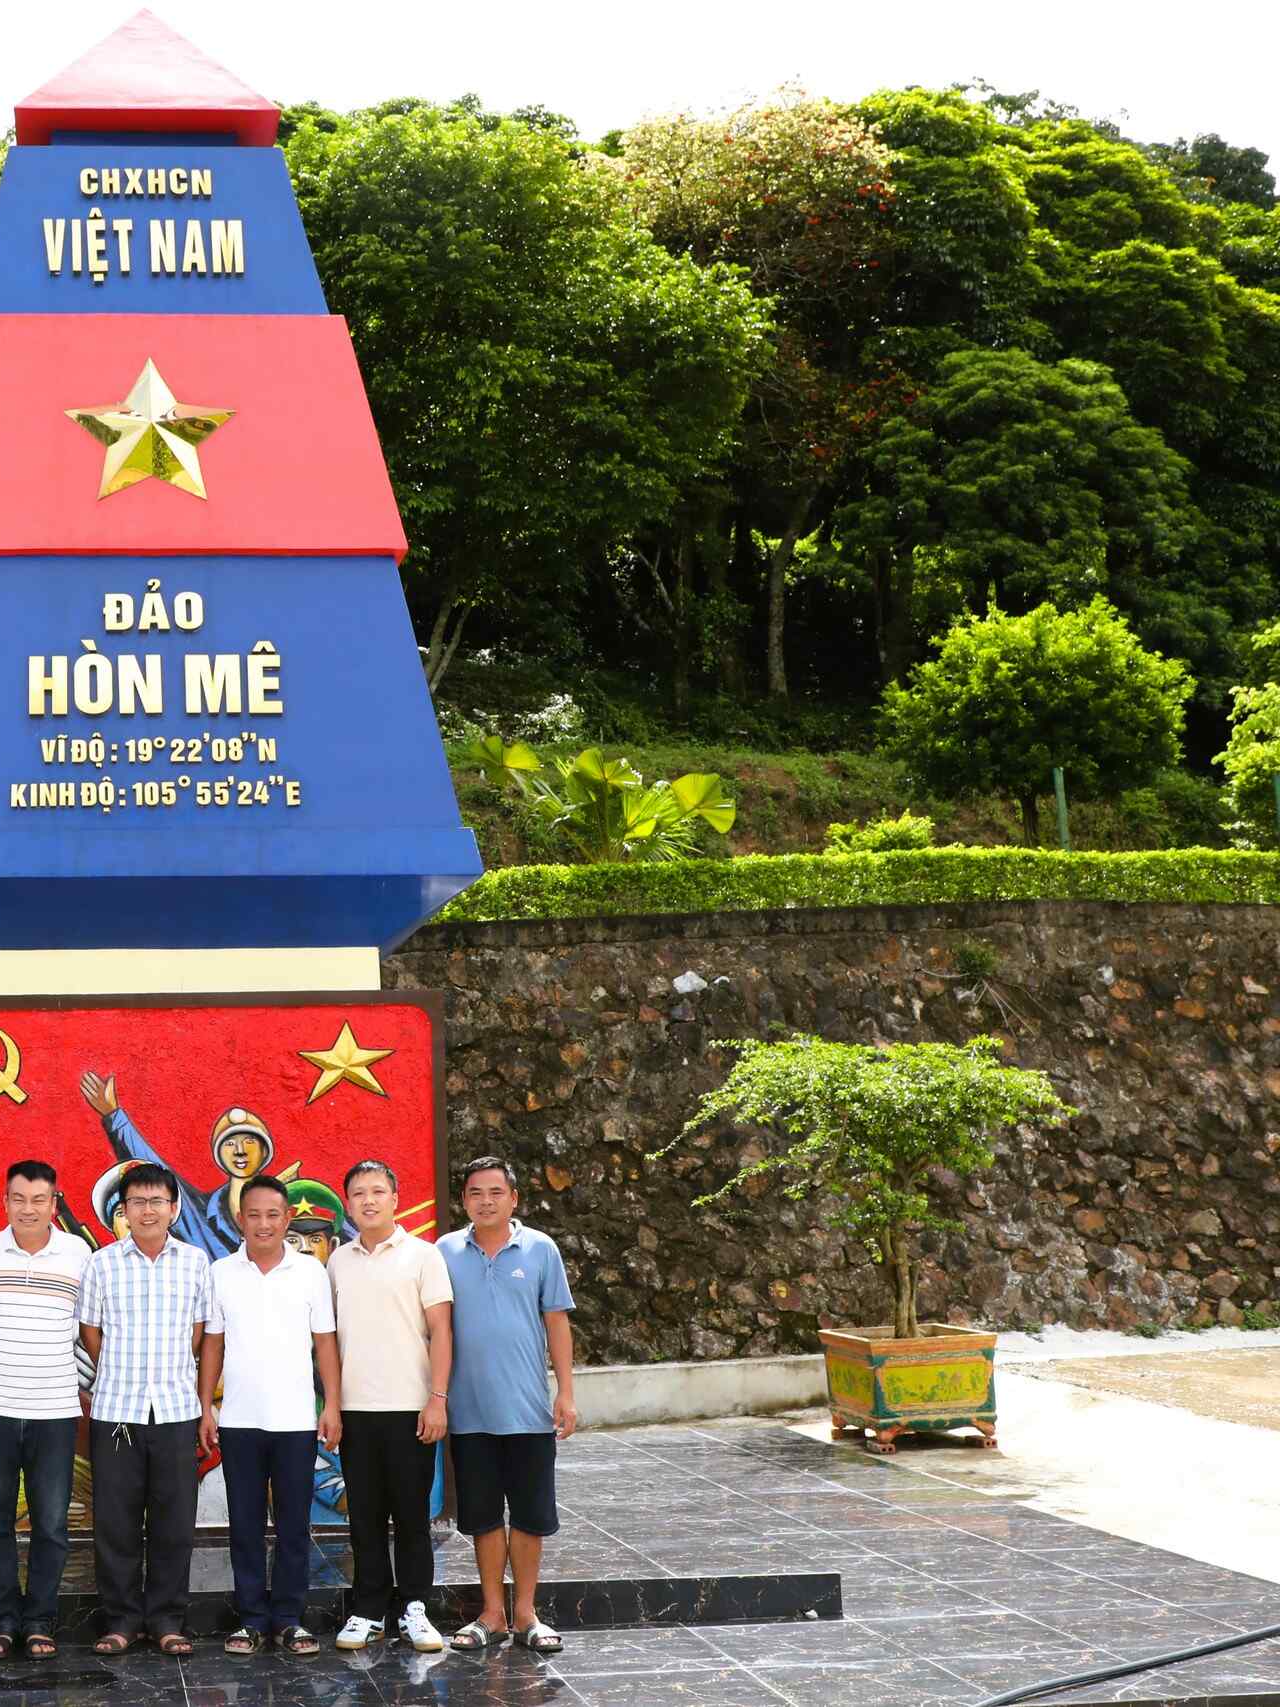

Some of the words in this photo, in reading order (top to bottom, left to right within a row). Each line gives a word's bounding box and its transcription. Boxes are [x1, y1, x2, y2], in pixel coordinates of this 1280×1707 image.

[79, 167, 212, 197] CHXHCN
[42, 206, 135, 283] VIỆT
[149, 218, 245, 274] NAM
[102, 578, 205, 632] ĐẢO
[28, 639, 164, 716] HÒN
[184, 640, 285, 715] MÊ
[40, 734, 68, 763] VĨ
[10, 782, 76, 808] KINH
